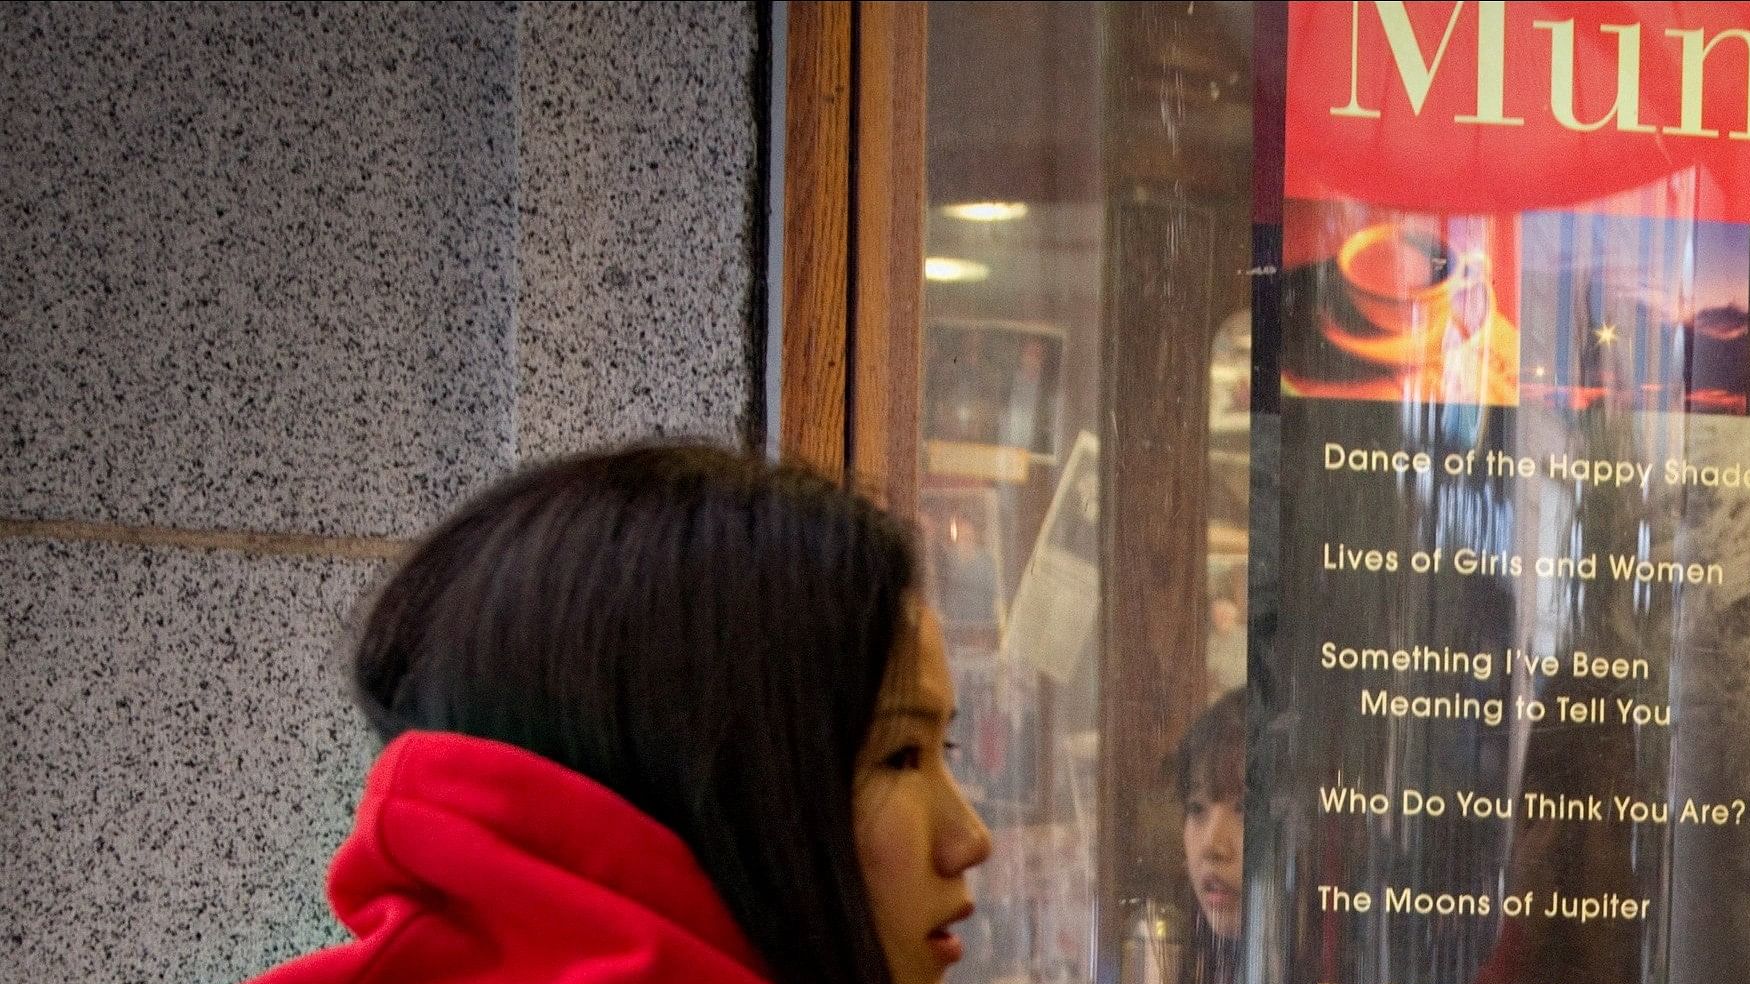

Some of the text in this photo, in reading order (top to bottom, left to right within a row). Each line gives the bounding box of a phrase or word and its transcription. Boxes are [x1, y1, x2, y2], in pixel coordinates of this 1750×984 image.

[1324, 443, 1432, 473] Dance
[1444, 450, 1477, 475] of
[1487, 452, 1536, 478] the
[1550, 454, 1652, 489] Happy
[1323, 543, 1723, 585] Lives of Girls and Women
[1321, 642, 1649, 680] Something I've Been
[1361, 690, 1671, 726] Meaning to Tell You
[1320, 786, 1746, 825] Who Do You Think You Are?
[1317, 886, 1650, 923] The Moons of Jupiter
